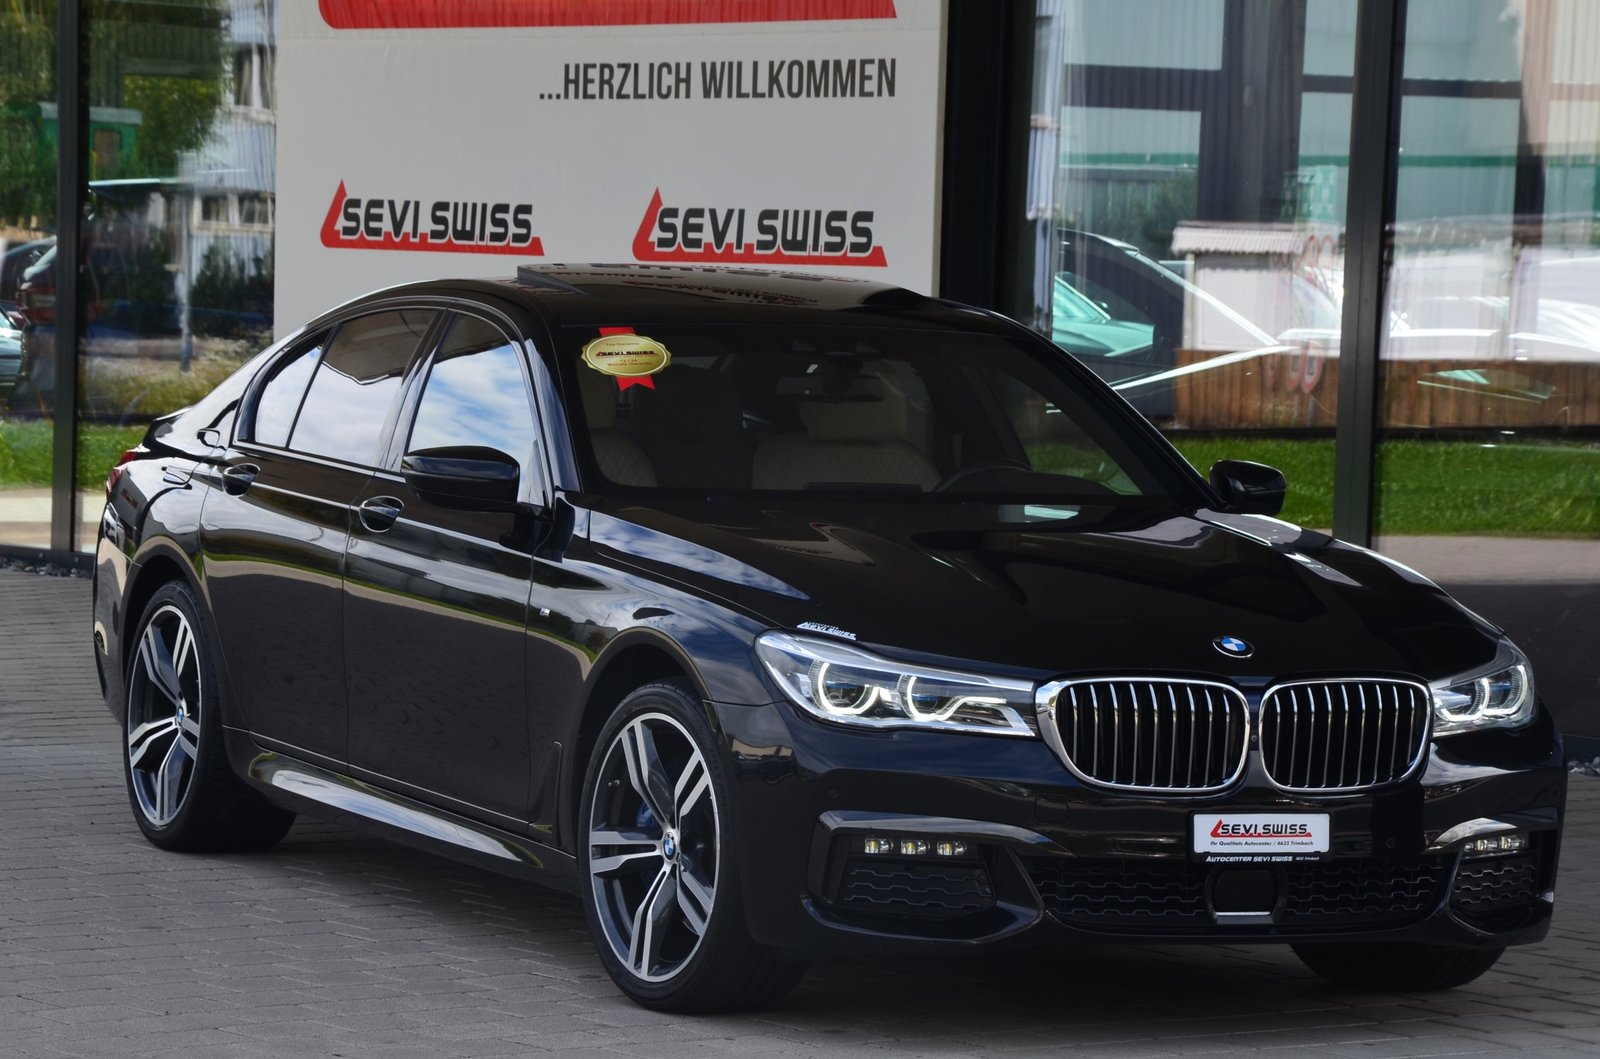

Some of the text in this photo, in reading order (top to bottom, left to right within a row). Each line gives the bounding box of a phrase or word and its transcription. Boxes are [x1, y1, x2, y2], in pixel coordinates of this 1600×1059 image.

[539, 58, 896, 100] ...HERZLICH WILLKOMMEN
[342, 198, 533, 244] SEVI SWISS
[656, 207, 874, 253] SEVI SWISS
[1220, 824, 1308, 835] SEVI SWISS
